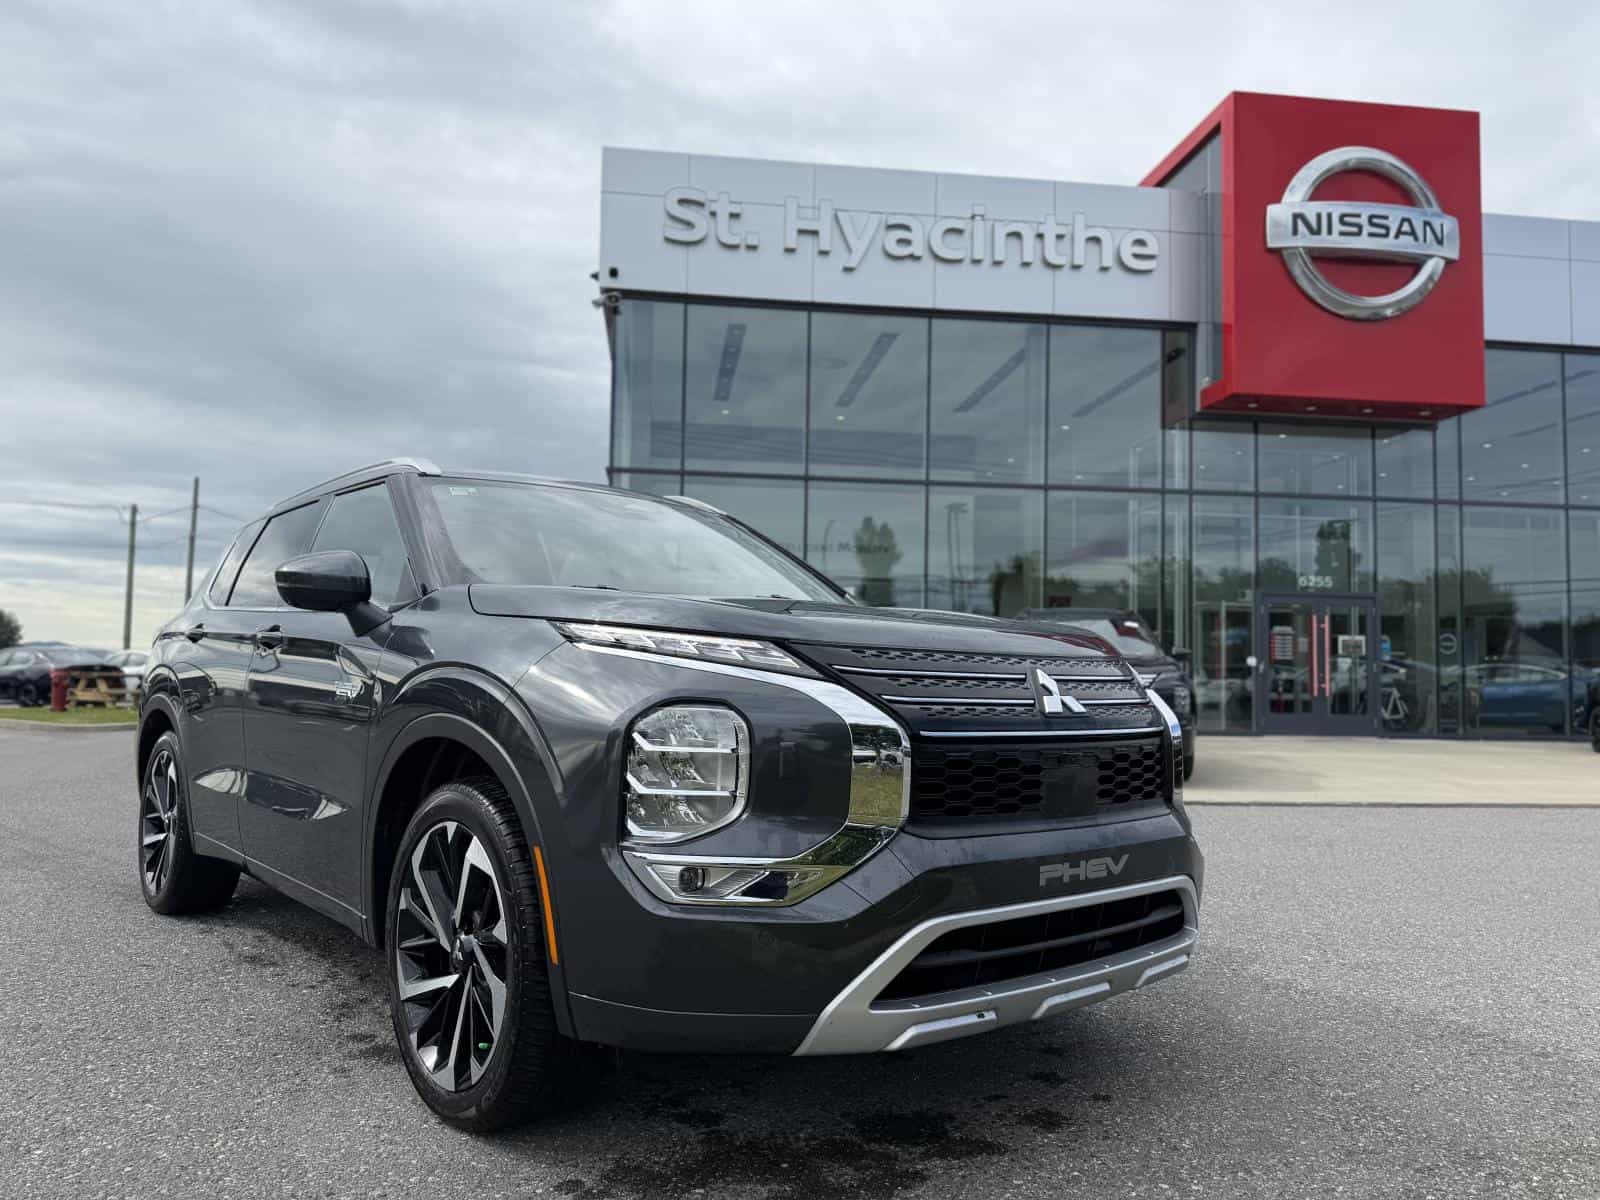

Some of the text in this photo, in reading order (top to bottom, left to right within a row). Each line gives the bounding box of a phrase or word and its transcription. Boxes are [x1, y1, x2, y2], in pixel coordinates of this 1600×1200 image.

[663, 186, 1159, 272] St. Hyacinthe
[1291, 212, 1445, 246] NISSAN
[1039, 853, 1130, 887] PHEV
